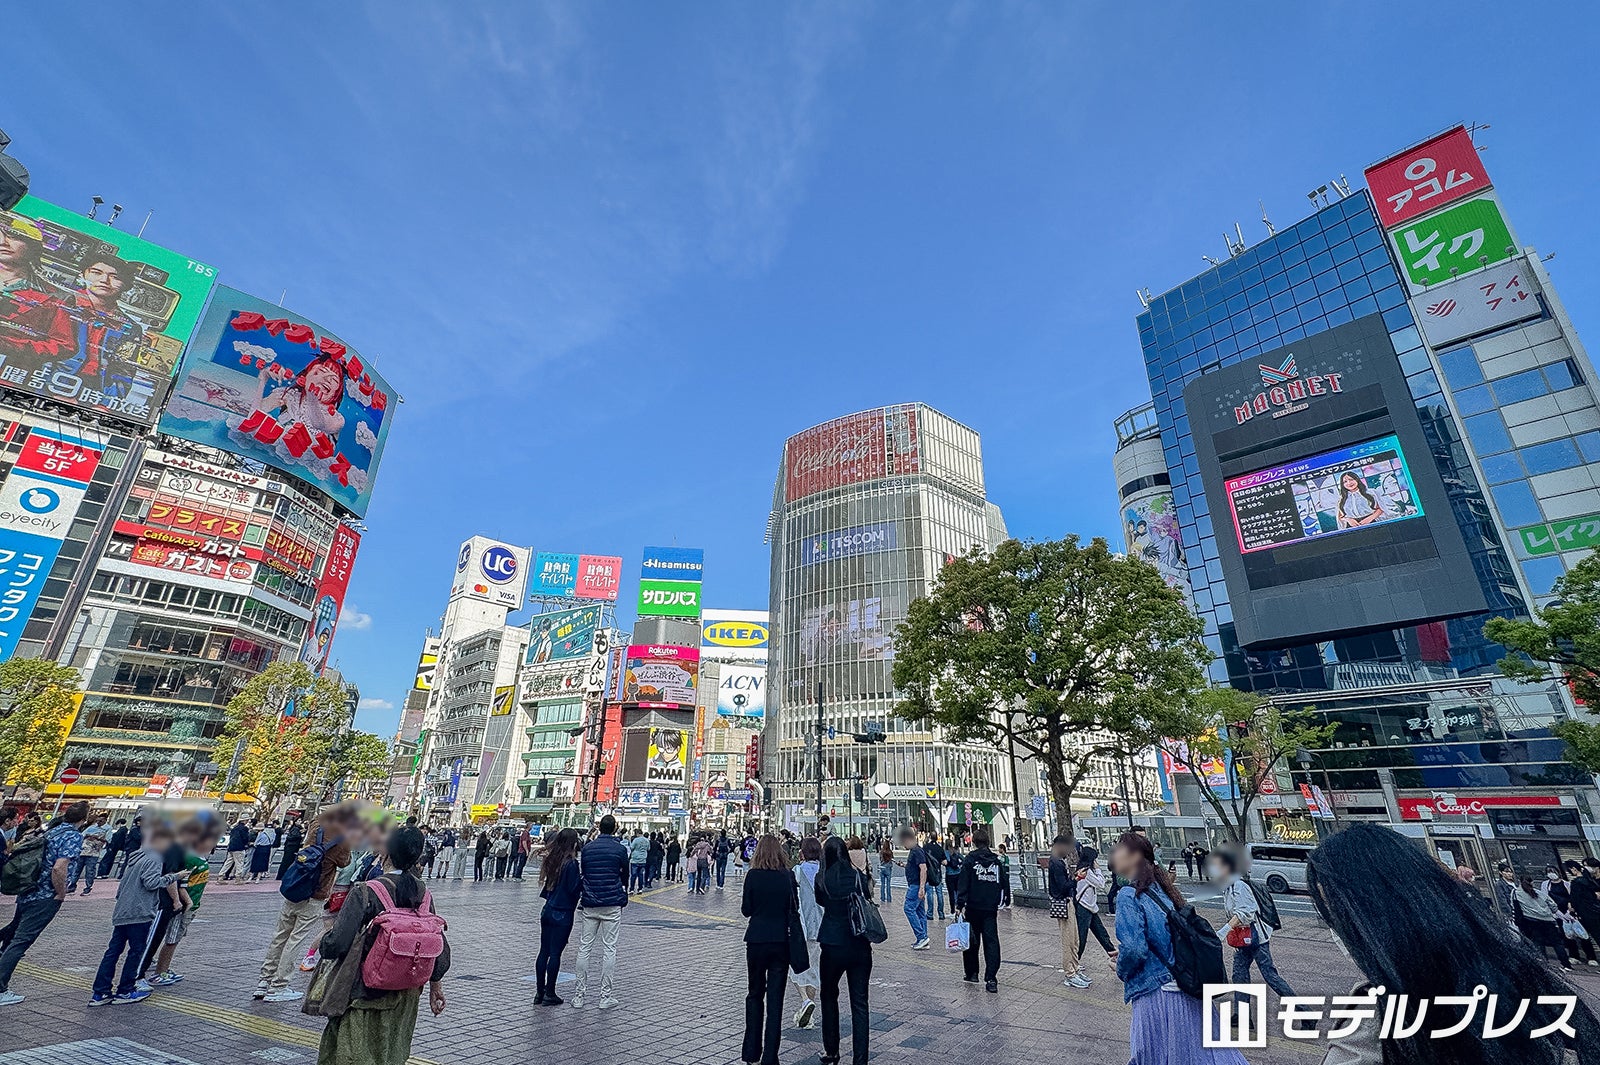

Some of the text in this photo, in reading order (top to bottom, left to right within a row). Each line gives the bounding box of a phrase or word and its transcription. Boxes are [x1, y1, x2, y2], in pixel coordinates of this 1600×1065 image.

[1387, 168, 1474, 213] アコム
[1404, 228, 1484, 271] レイク
[187, 260, 214, 278] TBS
[1233, 373, 1343, 425] MAGNET
[36, 441, 88, 463] 当ビル
[43, 459, 73, 473] 5F
[140, 468, 160, 481] 9F
[162, 453, 259, 485] しゃぶしゃぶバイキング
[1288, 464, 1310, 474] NEWS
[1240, 469, 1286, 487] モデルプレス
[195, 479, 252, 504] しゃぶ葉
[0, 510, 61, 532] eyecity
[150, 502, 245, 536] プライス
[1526, 520, 1600, 548] レイク
[109, 541, 135, 555] 7F
[201, 540, 246, 559] ガスト
[266, 531, 314, 563] コンタクト
[163, 550, 223, 574] ガスト
[484, 553, 516, 575] UC
[643, 558, 702, 570] Hisamitsu
[232, 566, 250, 578] ガスト
[539, 572, 573, 585] ダイレクト
[582, 575, 616, 588] ダイレクト
[499, 590, 515, 601] VISA
[642, 589, 697, 606] サロンパス
[709, 627, 766, 640] IKEA
[590, 630, 608, 689] もんじゃ
[648, 646, 679, 656] Rakuten
[720, 674, 764, 691] ACN
[1406, 713, 1477, 731] 星乃珈琲
[649, 766, 683, 781] DMM
[622, 791, 679, 804] 大盛堂店
[893, 789, 922, 797] TSUTAYA
[1436, 801, 1471, 815] Cozy
[1274, 824, 1315, 839] Dimoo
